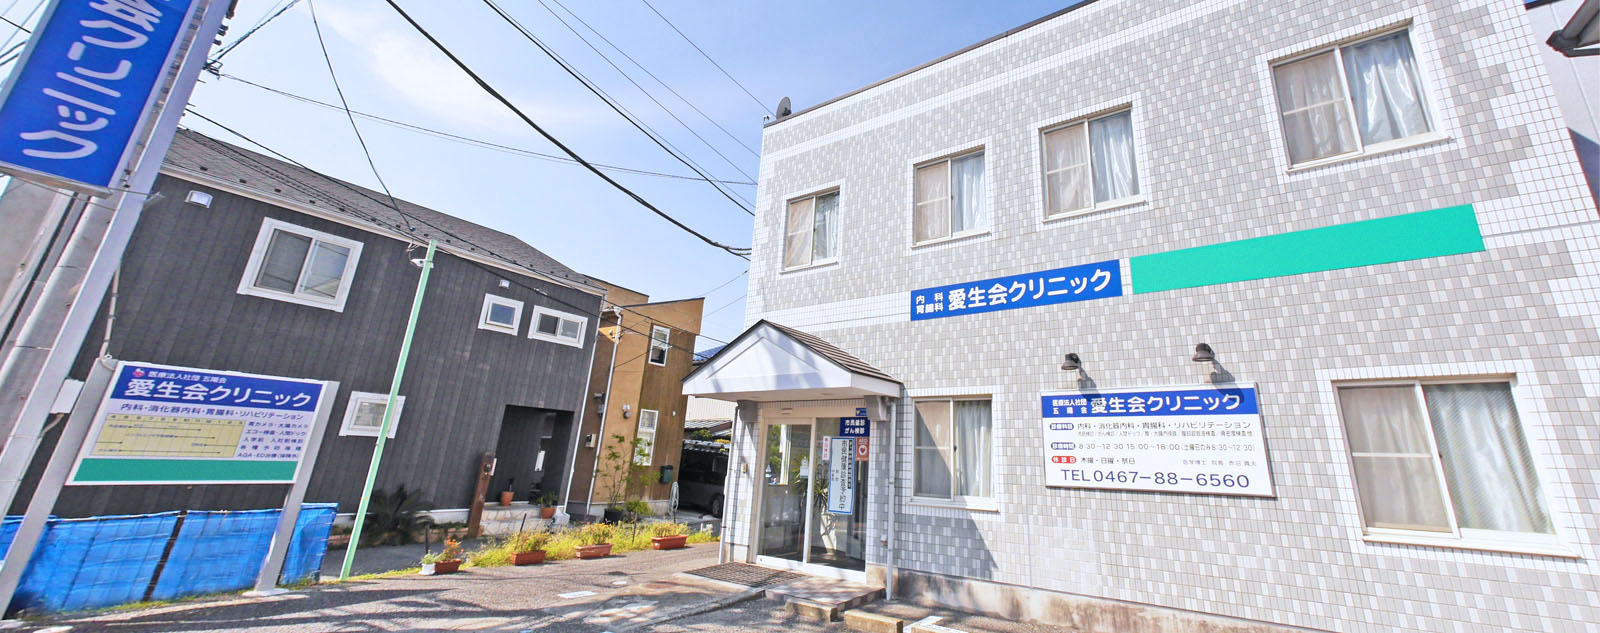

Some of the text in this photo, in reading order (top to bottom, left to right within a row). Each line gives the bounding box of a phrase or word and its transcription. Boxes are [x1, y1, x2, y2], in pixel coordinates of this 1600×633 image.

[948, 268, 1111, 311] 愛生会クリニック
[916, 302, 944, 315] 胃腸科
[148, 371, 201, 381] 医療法人社団
[124, 379, 311, 407] 愛生会クリニック
[121, 403, 304, 420] 内科・消化器内科・胃腸科・リハビリテーション
[1090, 393, 1241, 414] 愛生会クリニック
[1077, 421, 1251, 430] 内科・消化器内科・胃腸科・リハビリテーション
